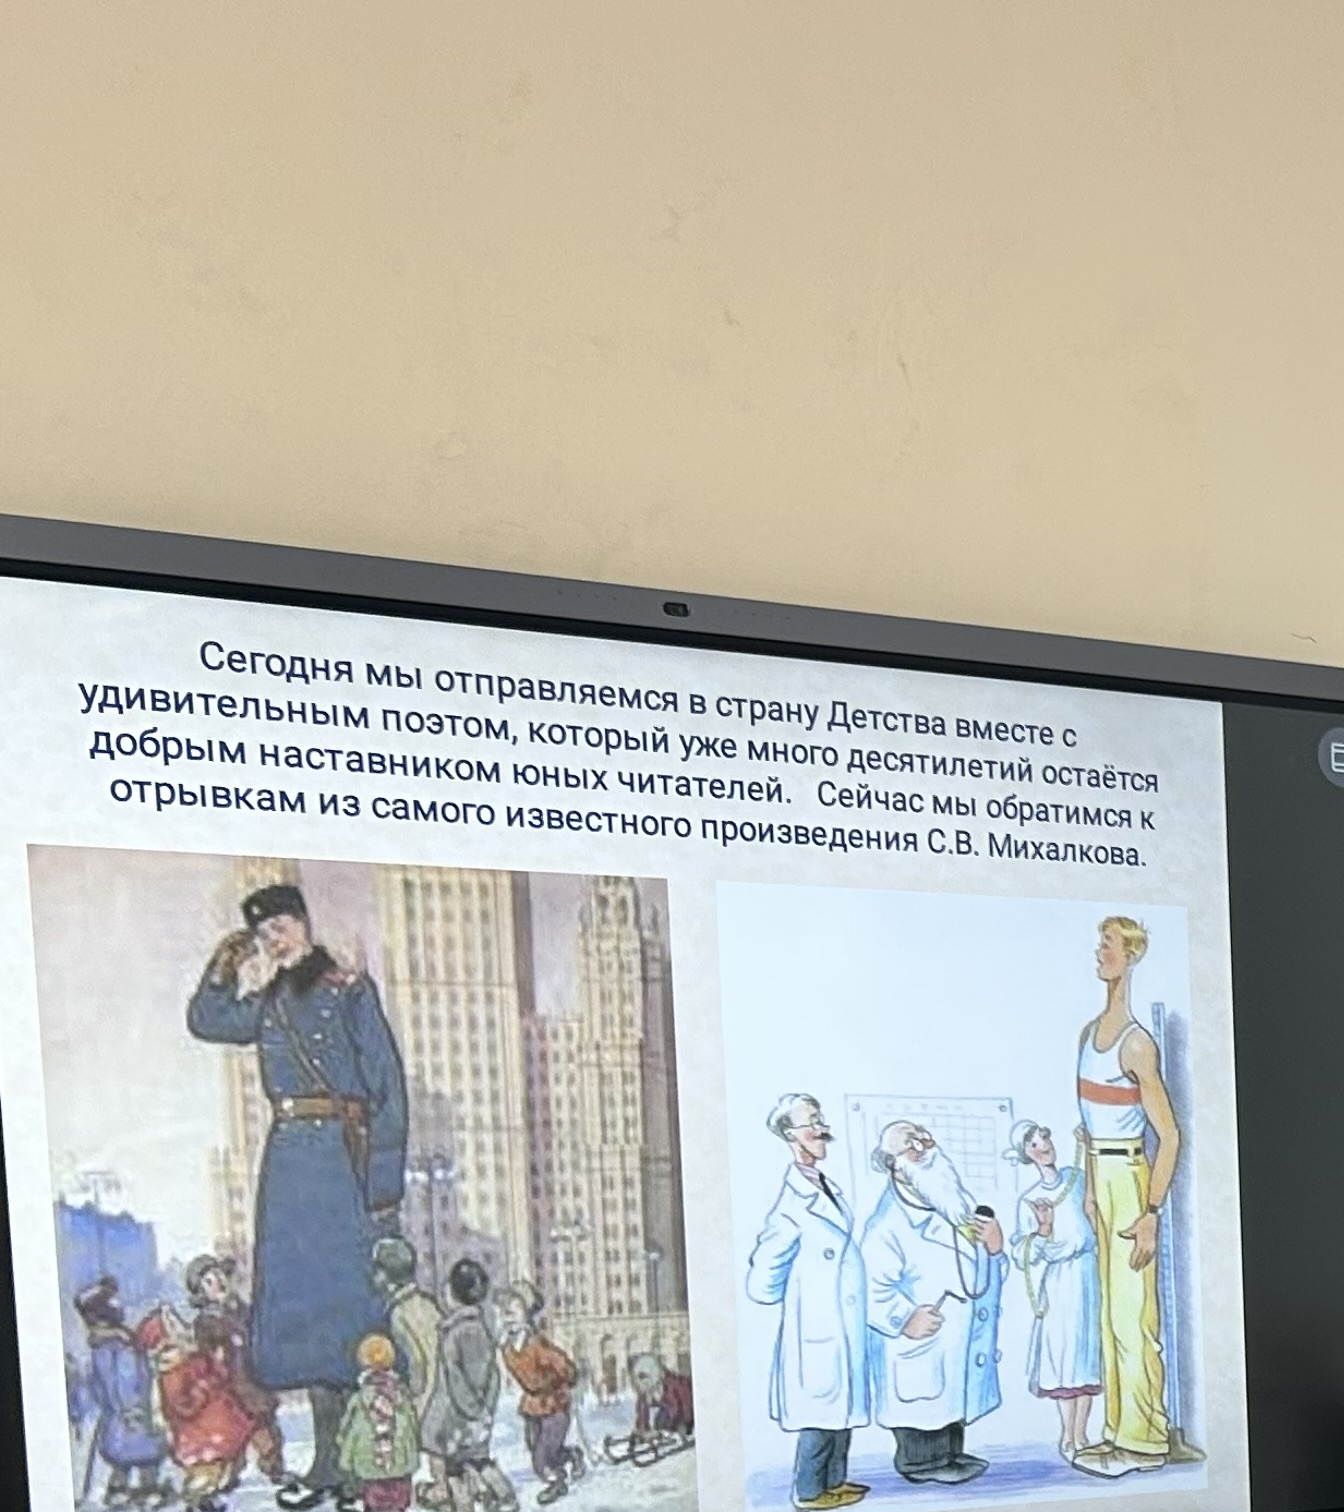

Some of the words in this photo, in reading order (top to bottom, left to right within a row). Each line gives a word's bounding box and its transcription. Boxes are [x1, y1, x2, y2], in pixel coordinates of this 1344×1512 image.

[79, 682, 369, 728] удивительным
[383, 708, 517, 745] поэтом,
[530, 722, 668, 755] который
[679, 734, 736, 761] уже
[748, 741, 838, 767] много
[847, 749, 1032, 782] десятилетий
[1043, 764, 1158, 793] остаётся
[201, 641, 353, 684] Сегодня
[366, 664, 422, 690] мы
[436, 671, 677, 713] отправляемся
[690, 694, 706, 714] в
[716, 697, 818, 730] страну
[828, 701, 945, 735] Детства
[957, 719, 1053, 745] вместе
[1063, 729, 1076, 747] с
[90, 727, 245, 765] добрым
[260, 744, 500, 782] наставником
[514, 764, 607, 790] юных
[618, 770, 791, 803] читателей.
[818, 781, 923, 813] Сейчас
[933, 794, 976, 816] мы
[987, 794, 1131, 828] обратимся
[1141, 811, 1155, 830] к
[111, 780, 305, 814] отрывкам
[320, 794, 359, 816] из
[373, 798, 494, 825] самого
[507, 807, 691, 837] известного
[702, 820, 917, 853] произведения
[928, 829, 978, 857] С.В.
[989, 833, 1146, 866] Михалкова.
